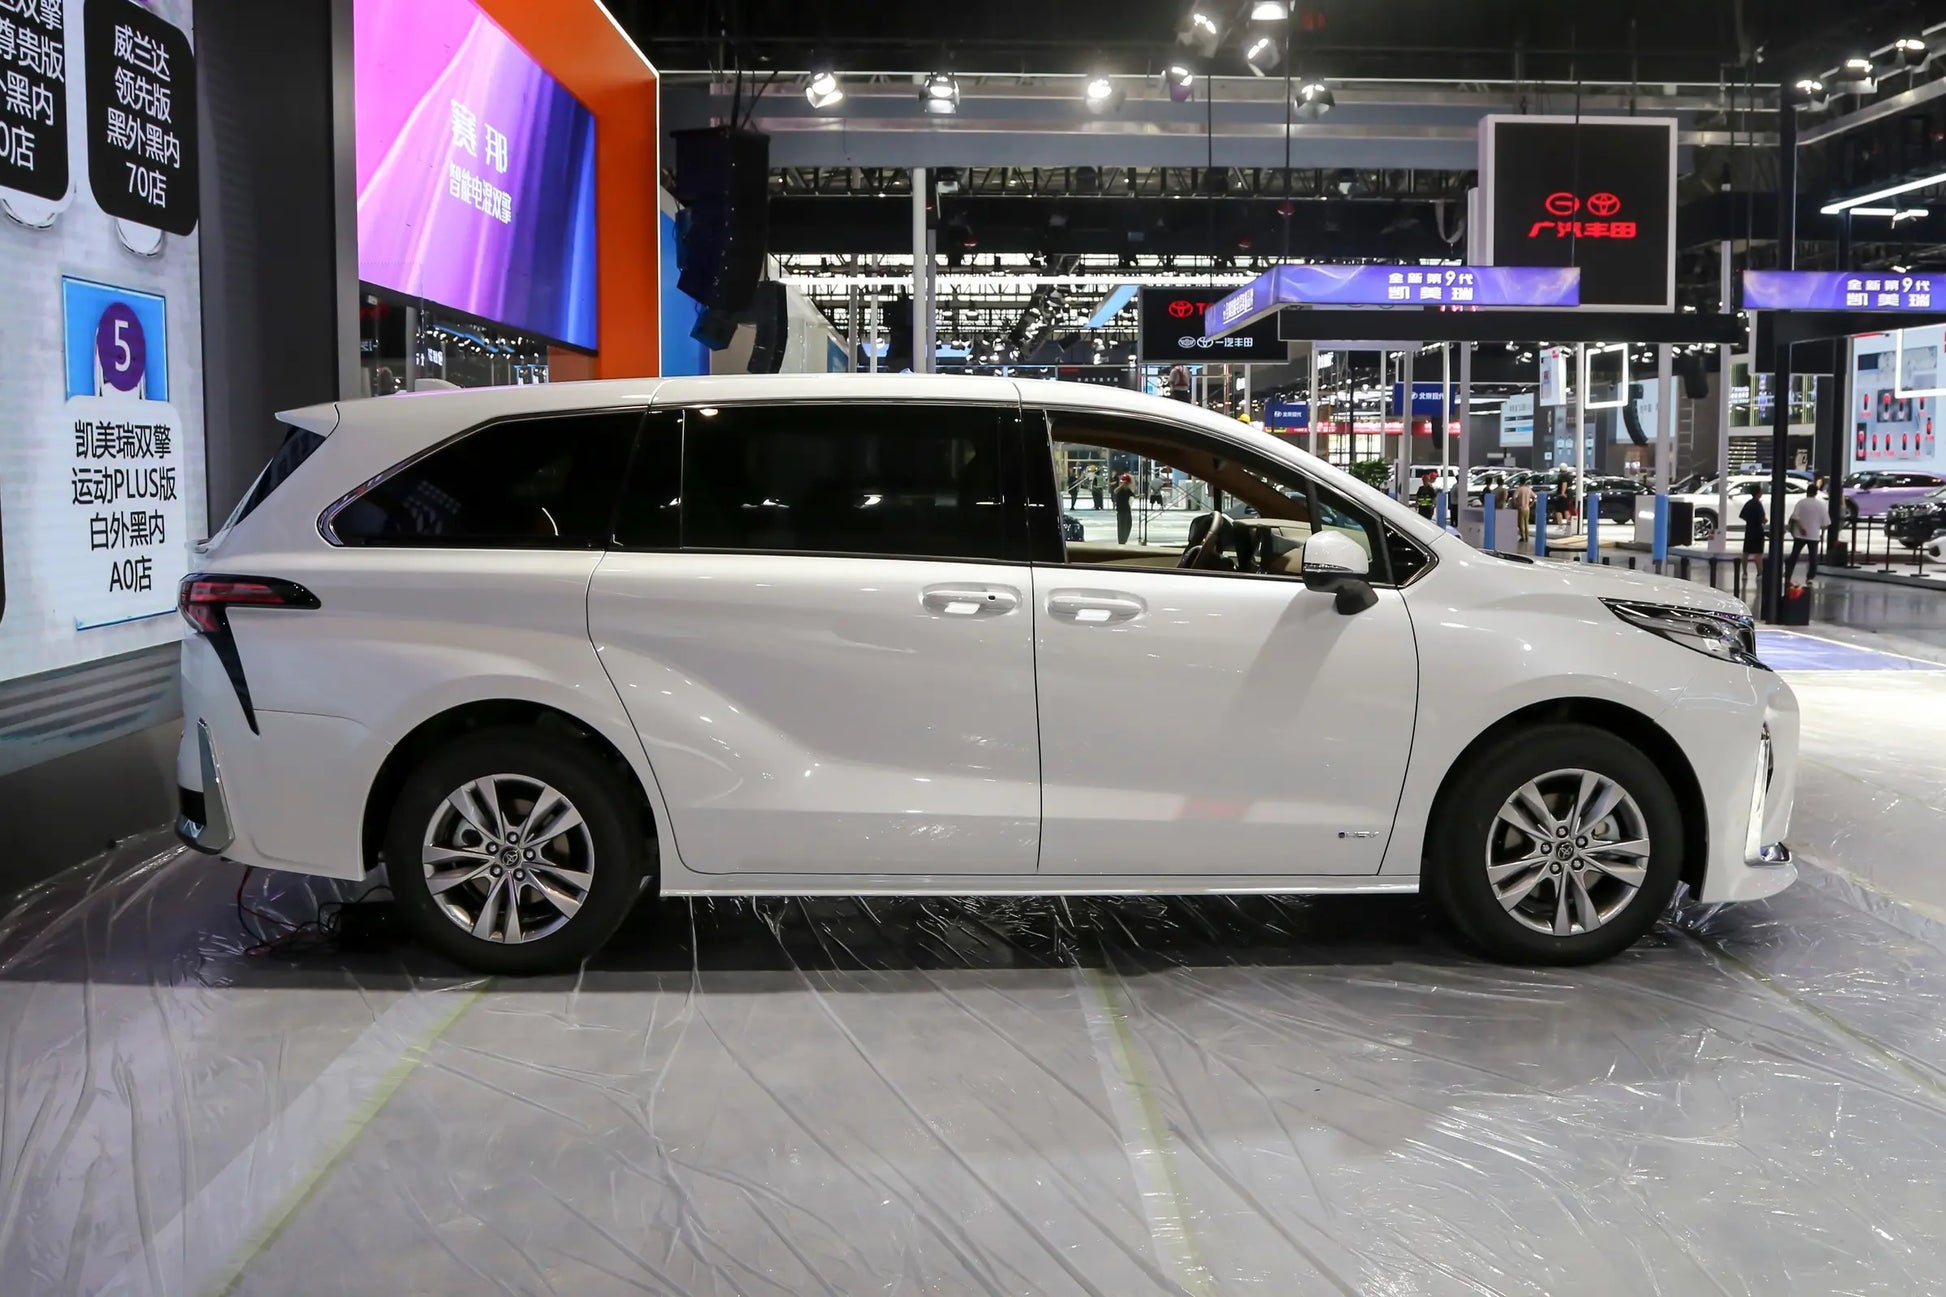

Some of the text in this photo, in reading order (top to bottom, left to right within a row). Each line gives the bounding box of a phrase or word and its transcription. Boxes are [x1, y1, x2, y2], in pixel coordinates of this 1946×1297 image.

[114, 24, 171, 82] 威兰达
[0, 70, 54, 126] 黑内
[115, 66, 172, 124] 领先版
[107, 107, 180, 168] 黑外黑内
[126, 161, 167, 208] 70店
[1528, 221, 1637, 238] 广汽丰田
[1388, 270, 1473, 286] 全新第9代
[1388, 286, 1473, 301] 凯美瑞
[1847, 277, 1930, 293] 全新第9代
[1847, 292, 1930, 307] 凯美瑞
[113, 319, 131, 372] 5
[1215, 337, 1253, 348] 一汽丰田
[75, 419, 171, 460] 凯美瑞双擎
[72, 467, 177, 505] 运动PLUS版
[90, 509, 165, 551] 白外黑内
